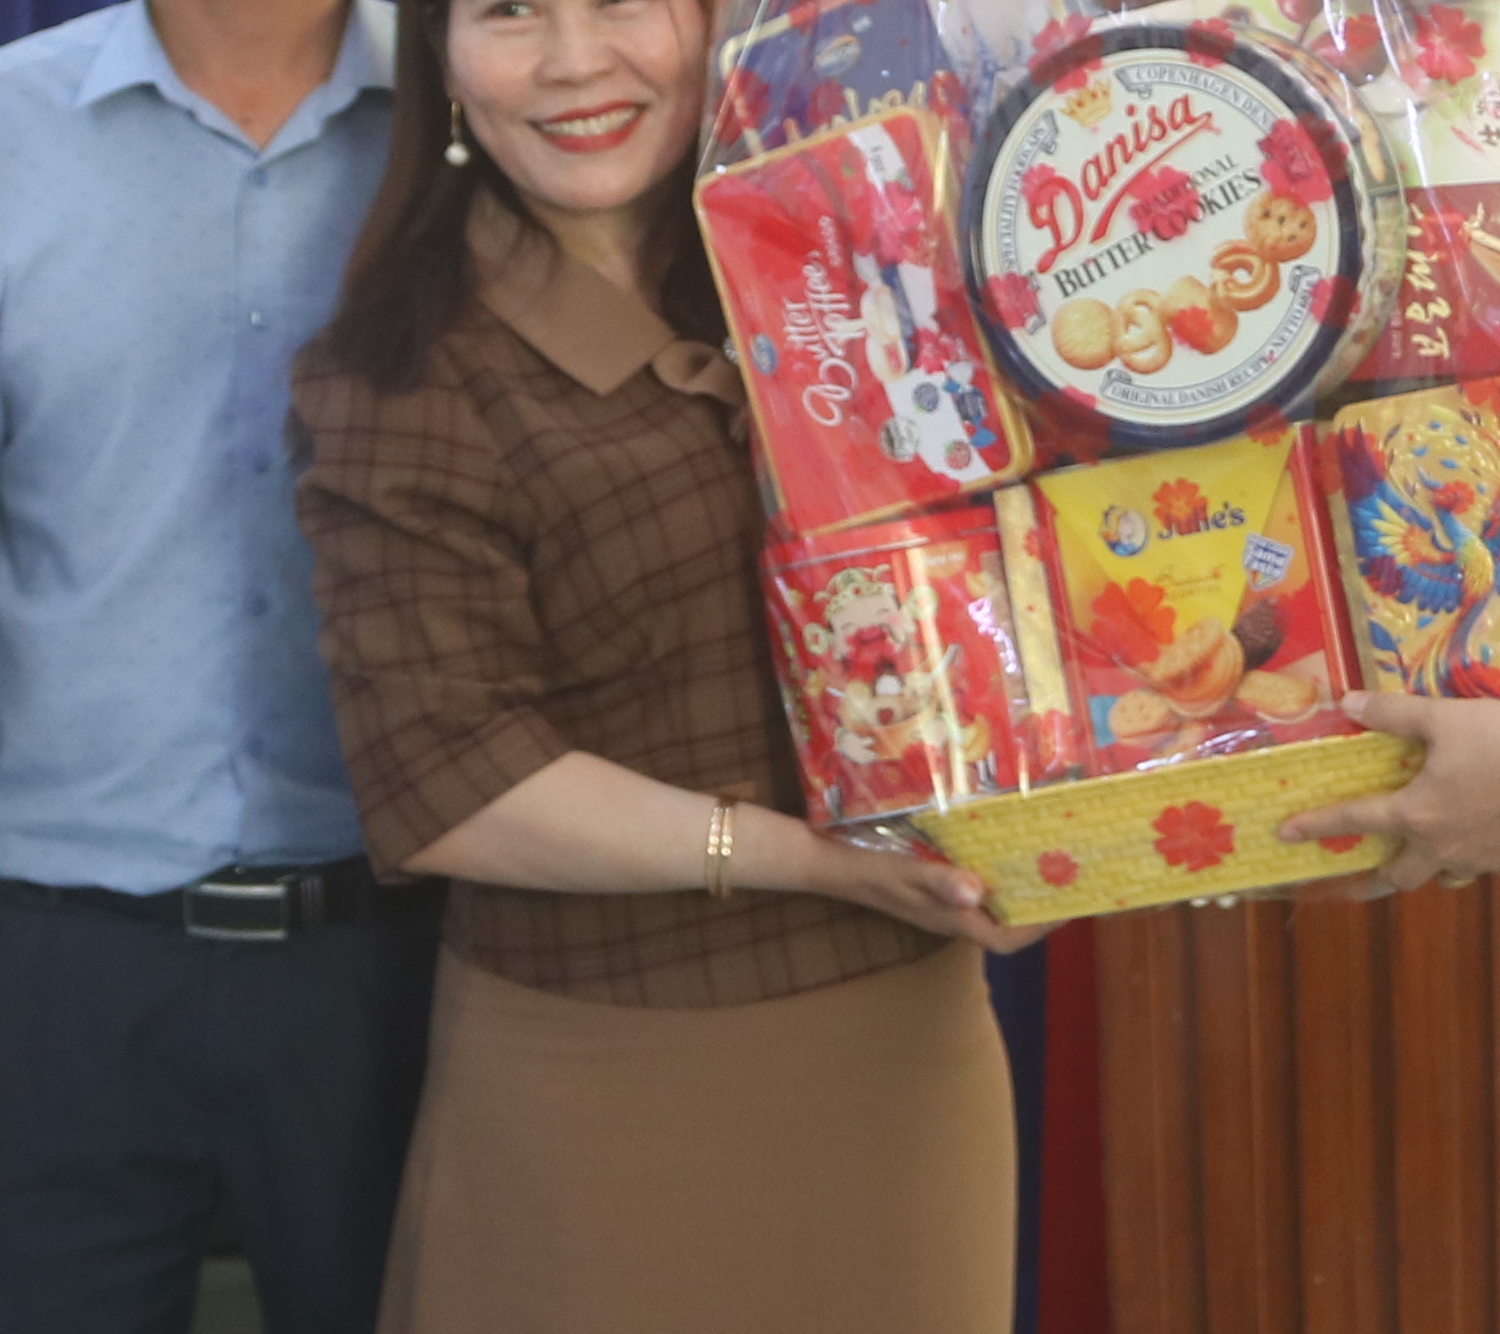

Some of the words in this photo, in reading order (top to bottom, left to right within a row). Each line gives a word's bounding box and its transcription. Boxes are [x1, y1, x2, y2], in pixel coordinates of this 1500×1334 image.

[1027, 94, 1212, 275] Danisa
[1152, 167, 1263, 242] COOKIES
[1054, 230, 1154, 298] BUTTER
[1157, 501, 1246, 540] Julie's
